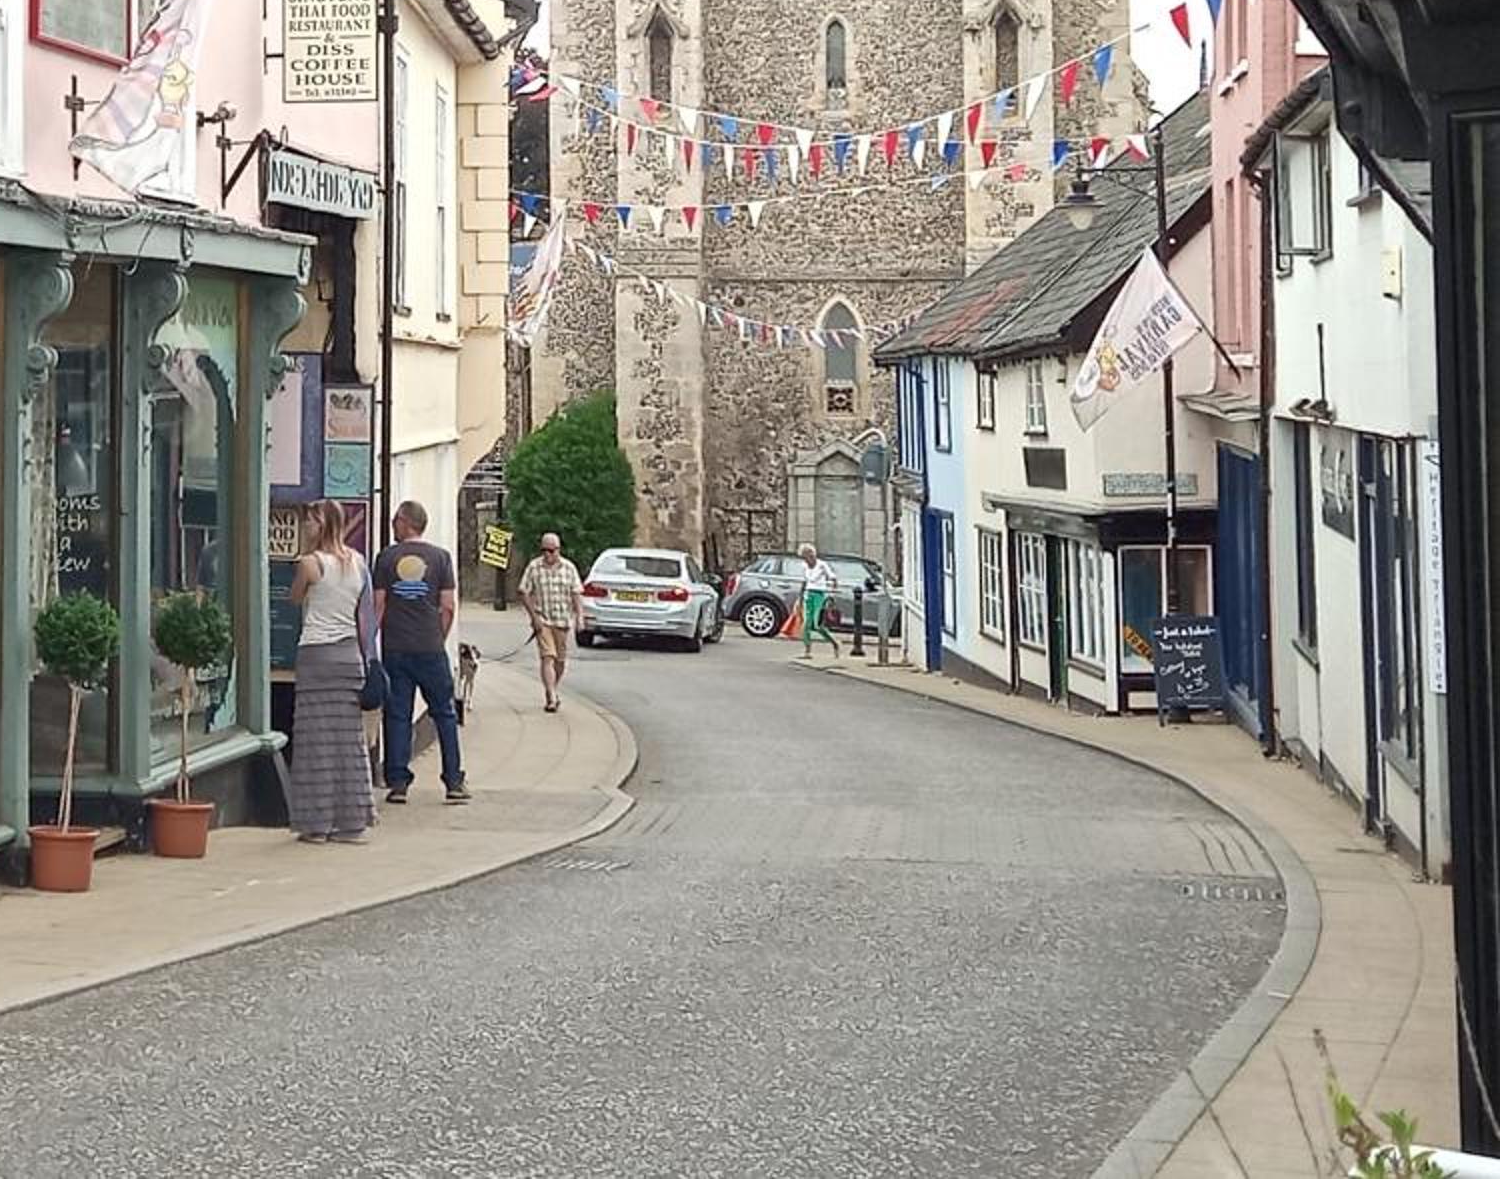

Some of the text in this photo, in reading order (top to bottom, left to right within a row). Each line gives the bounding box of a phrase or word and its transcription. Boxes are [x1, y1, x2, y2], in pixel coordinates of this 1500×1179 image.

[290, 3, 371, 18] THAI FOOD
[289, 19, 371, 32] RESTAURANT
[324, 33, 335, 43] &
[307, 44, 354, 56] DISS
[291, 58, 370, 71] COFFEE
[296, 73, 366, 86] HOUSE
